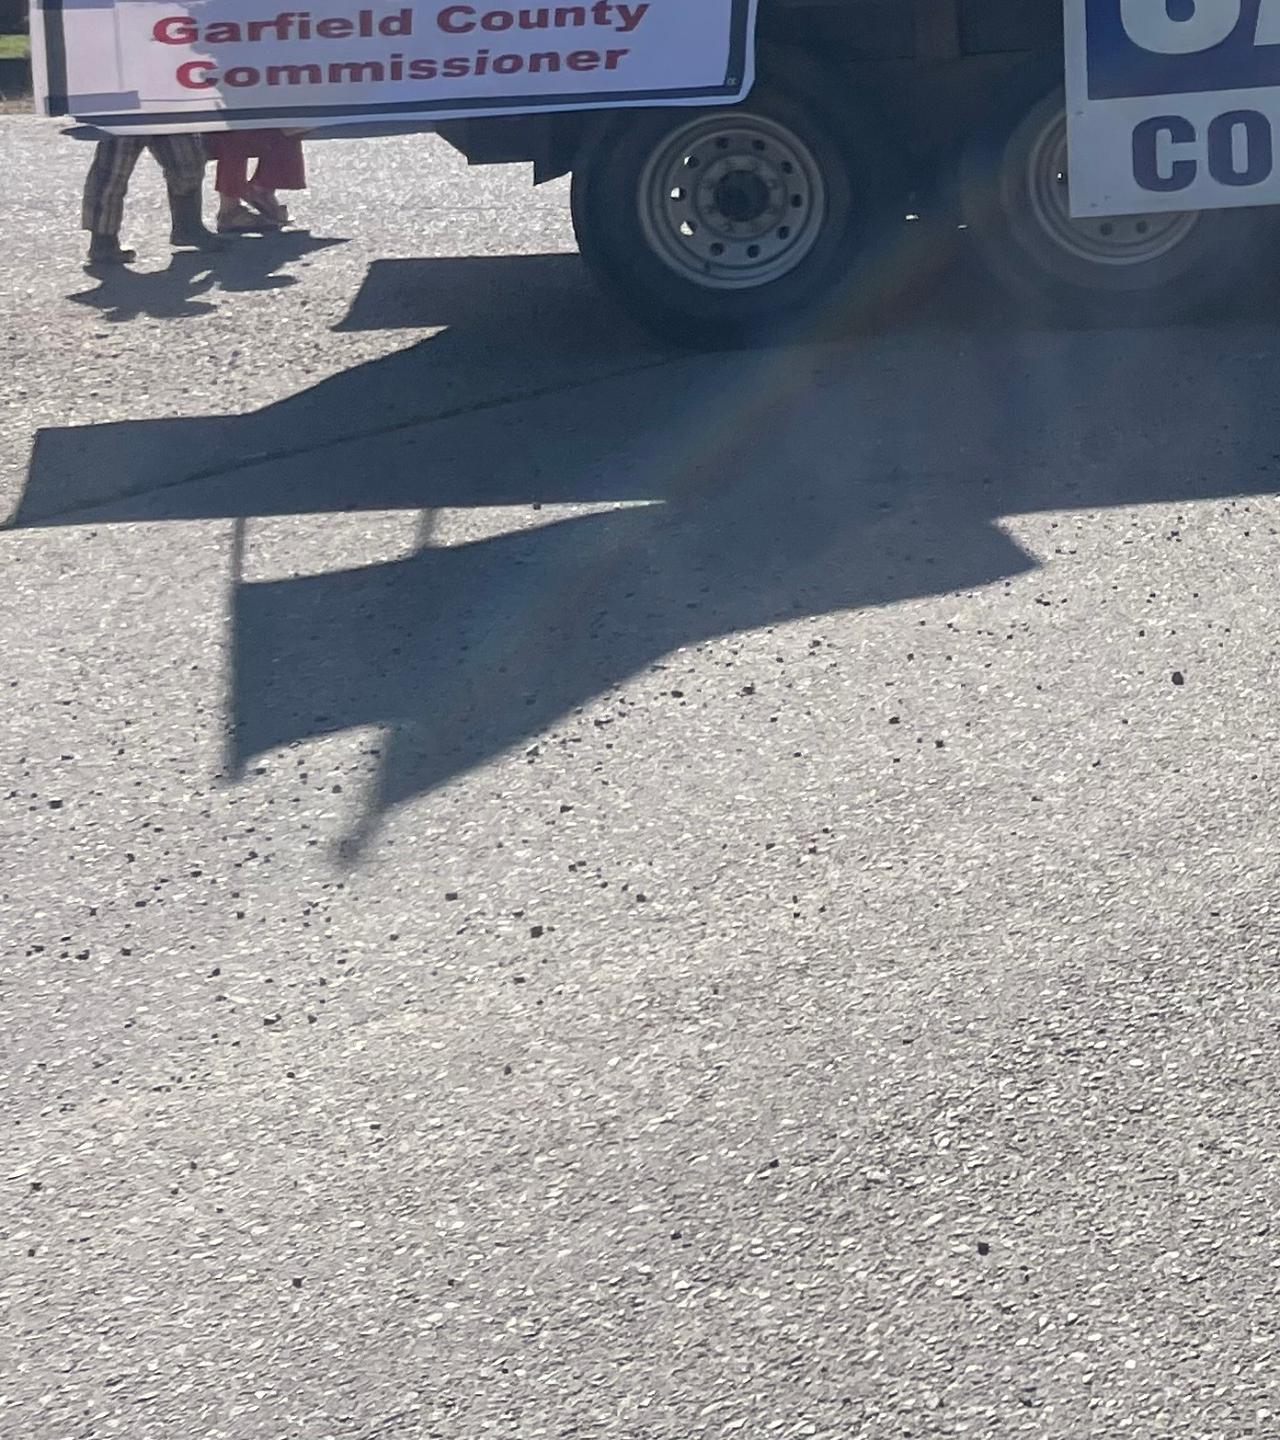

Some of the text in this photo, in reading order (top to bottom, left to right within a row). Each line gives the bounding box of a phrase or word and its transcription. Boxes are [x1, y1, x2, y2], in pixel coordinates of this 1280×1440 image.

[153, 0, 652, 46] Garfield County
[176, 45, 630, 90] Commissioner
